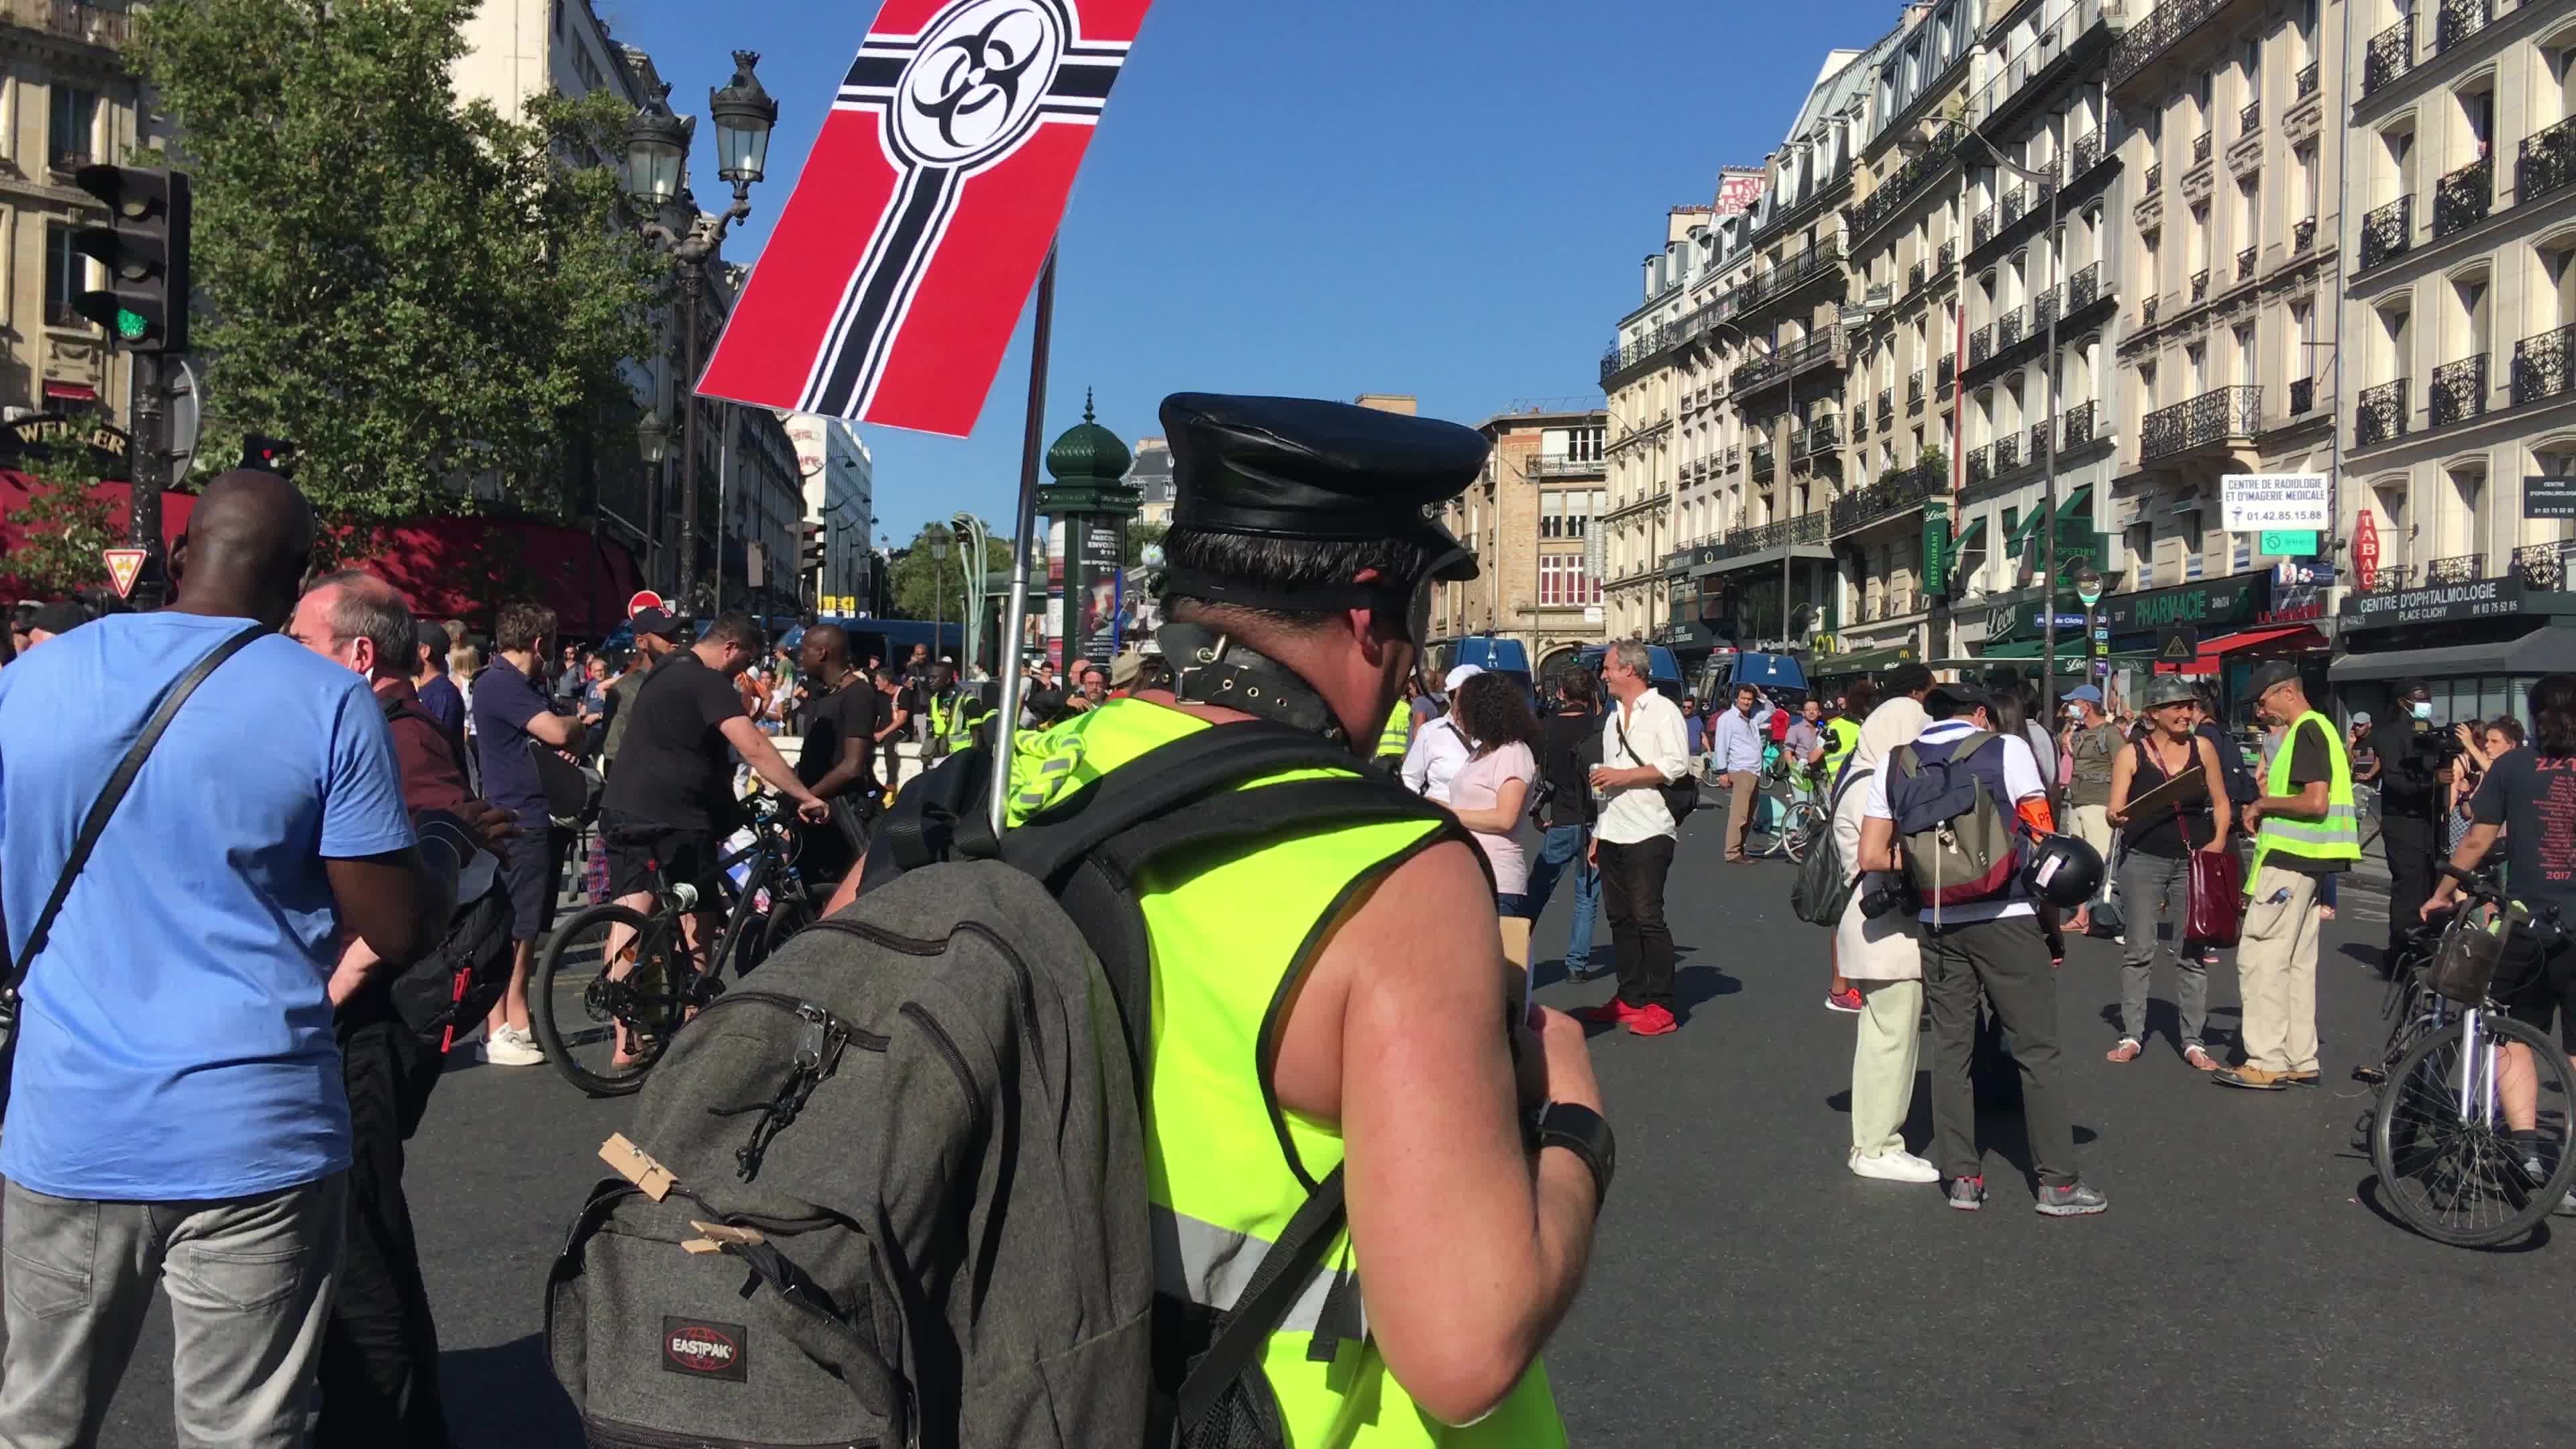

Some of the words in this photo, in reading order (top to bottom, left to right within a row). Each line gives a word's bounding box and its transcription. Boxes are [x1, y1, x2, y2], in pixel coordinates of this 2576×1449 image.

[2229, 480, 2259, 490] CENTRE
[2261, 479, 2272, 489] DE
[2275, 478, 2322, 489] RADIOLOGIE
[2226, 492, 2235, 502] ET
[2237, 490, 2284, 501] D'IMAGERIE
[2286, 490, 2324, 500] MEDICALE
[2247, 511, 2322, 521] 01.42.85.15.88
[2361, 515, 2376, 585] TABAC
[2360, 594, 2398, 613] CENTRE
[2400, 582, 2496, 609] D'OPHTALMOLOGIE
[2136, 590, 2206, 628] PHARMACIE
[2398, 610, 2421, 622] PLACE
[2421, 606, 2448, 620] CLICHY
[2473, 604, 2480, 615] 01
[2545, 871, 2571, 880] 2017
[673, 1338, 731, 1358] EASTPAK
